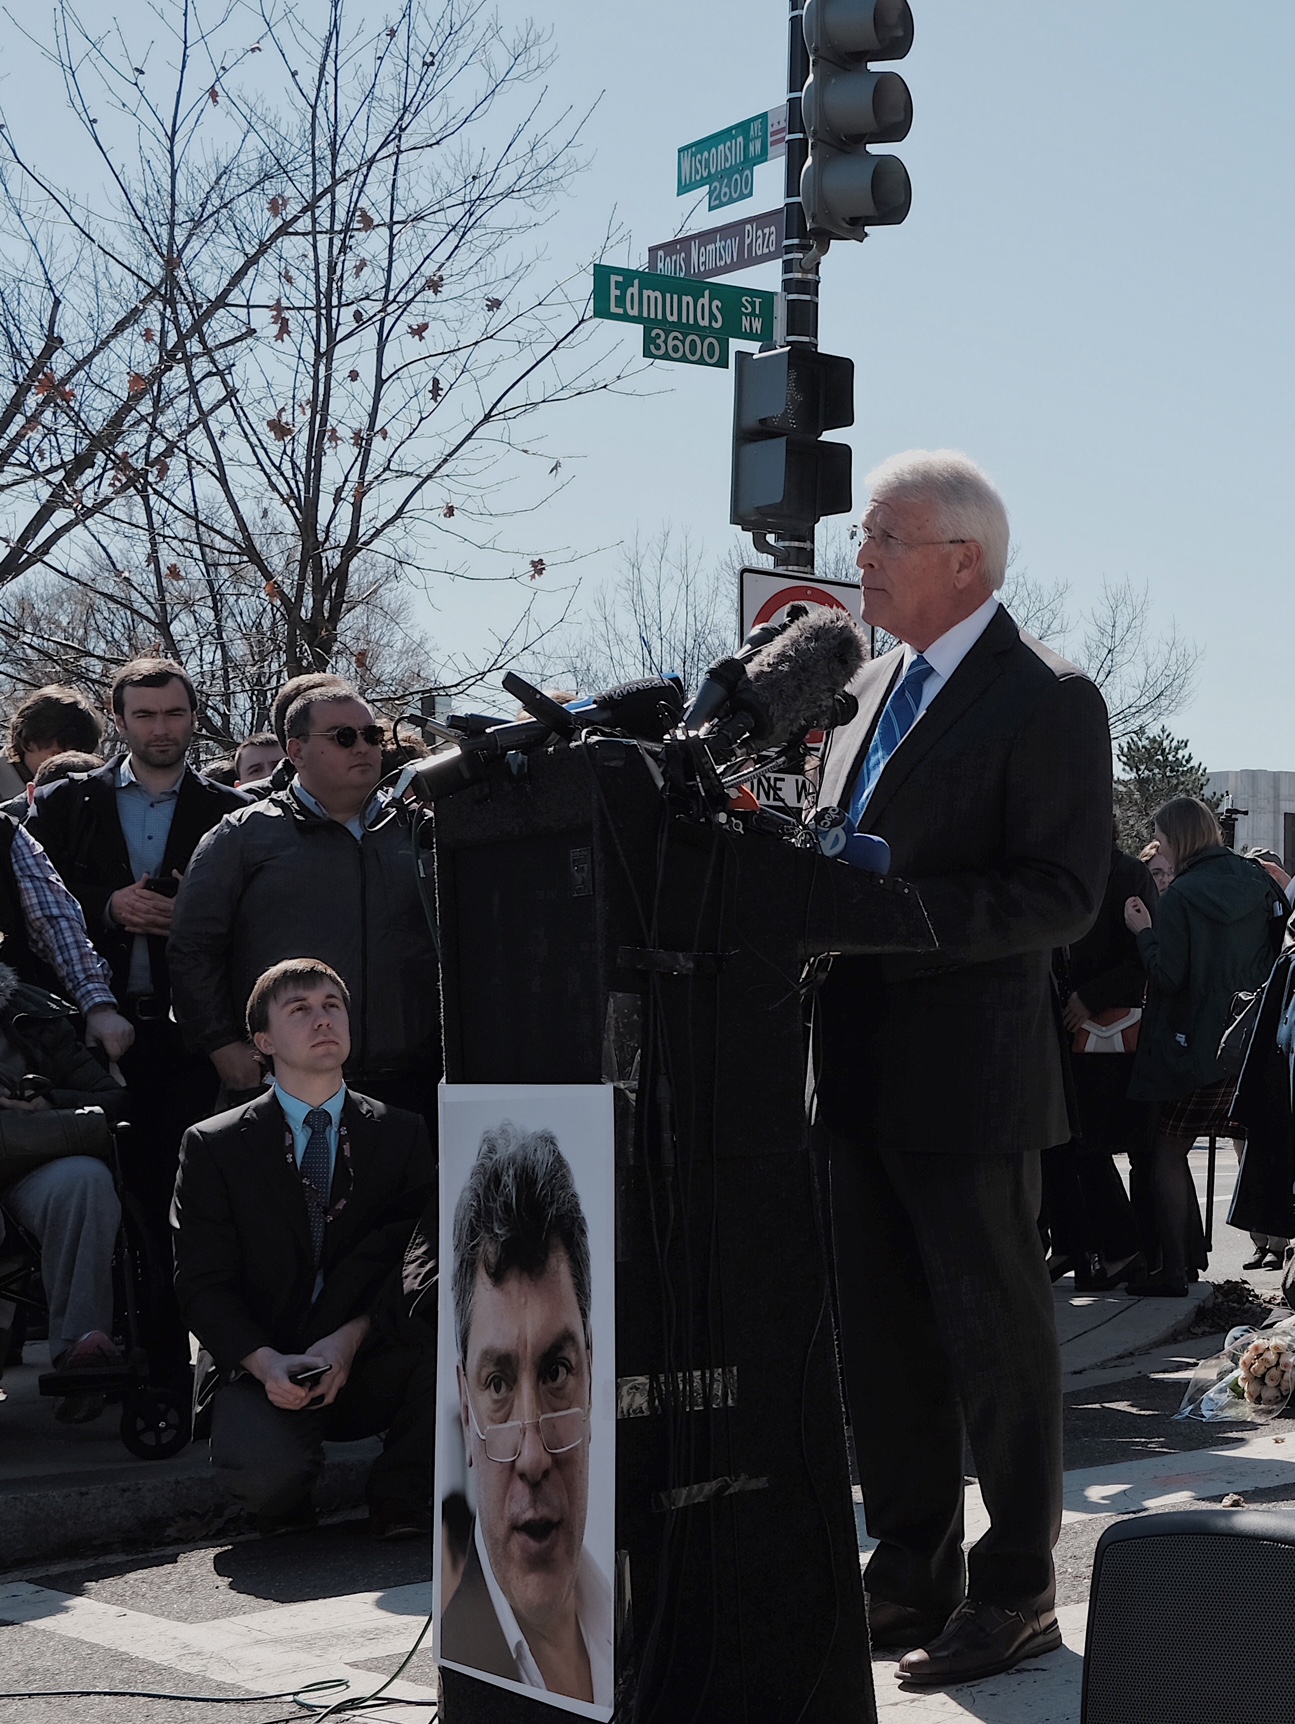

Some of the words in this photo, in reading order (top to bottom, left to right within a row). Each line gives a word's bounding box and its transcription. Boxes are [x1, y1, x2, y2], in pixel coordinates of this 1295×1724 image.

[749, 119, 762, 139] AVE
[681, 129, 744, 186] Wisconsin
[749, 137, 762, 158] NW
[710, 169, 752, 207] 2600
[657, 245, 686, 277] Boris
[690, 233, 740, 275] Nemtsov
[744, 222, 776, 260] Plaza
[609, 274, 723, 329] Edmunds
[741, 296, 763, 315] ST
[741, 315, 762, 335] NW
[649, 328, 720, 364] 3600
